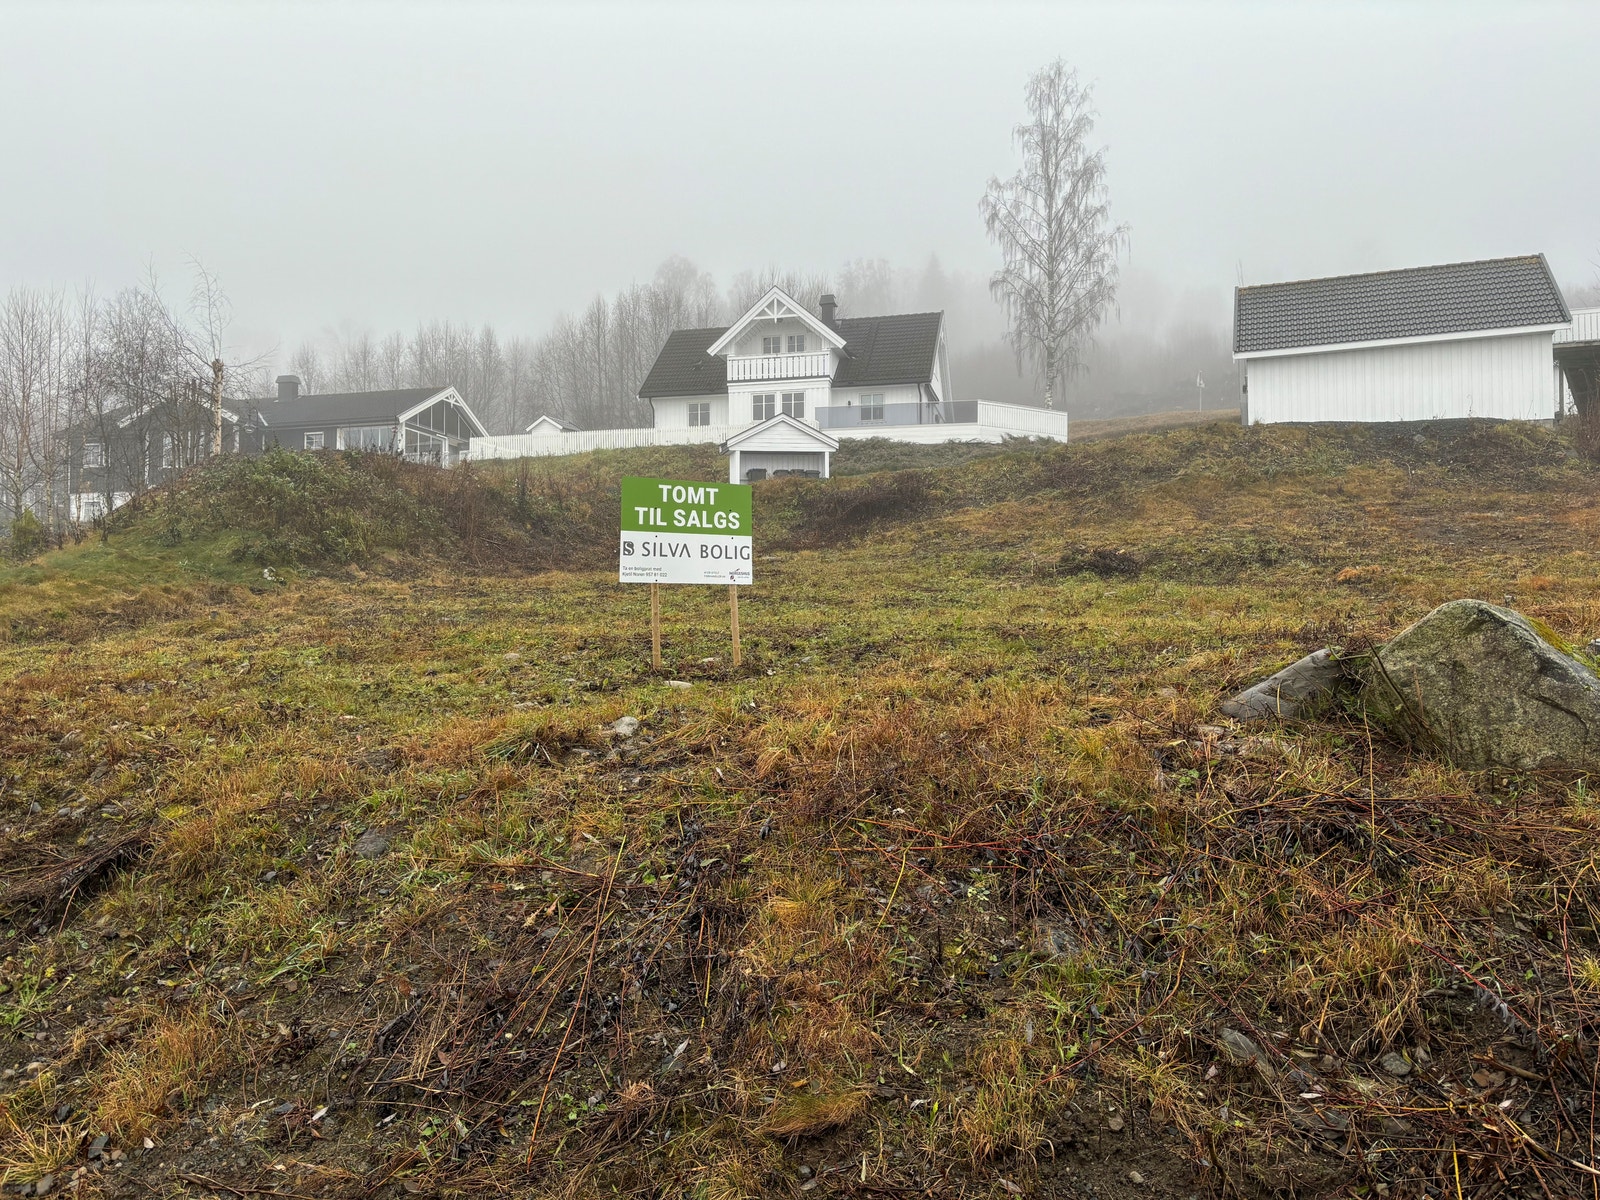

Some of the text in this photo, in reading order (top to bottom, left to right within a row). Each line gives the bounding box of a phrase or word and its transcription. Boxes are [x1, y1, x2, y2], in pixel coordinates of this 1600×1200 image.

[658, 484, 719, 505] TOMT
[634, 506, 741, 529] TIL SALGS
[641, 541, 691, 558] SILVA
[700, 544, 751, 560] BOLIG
